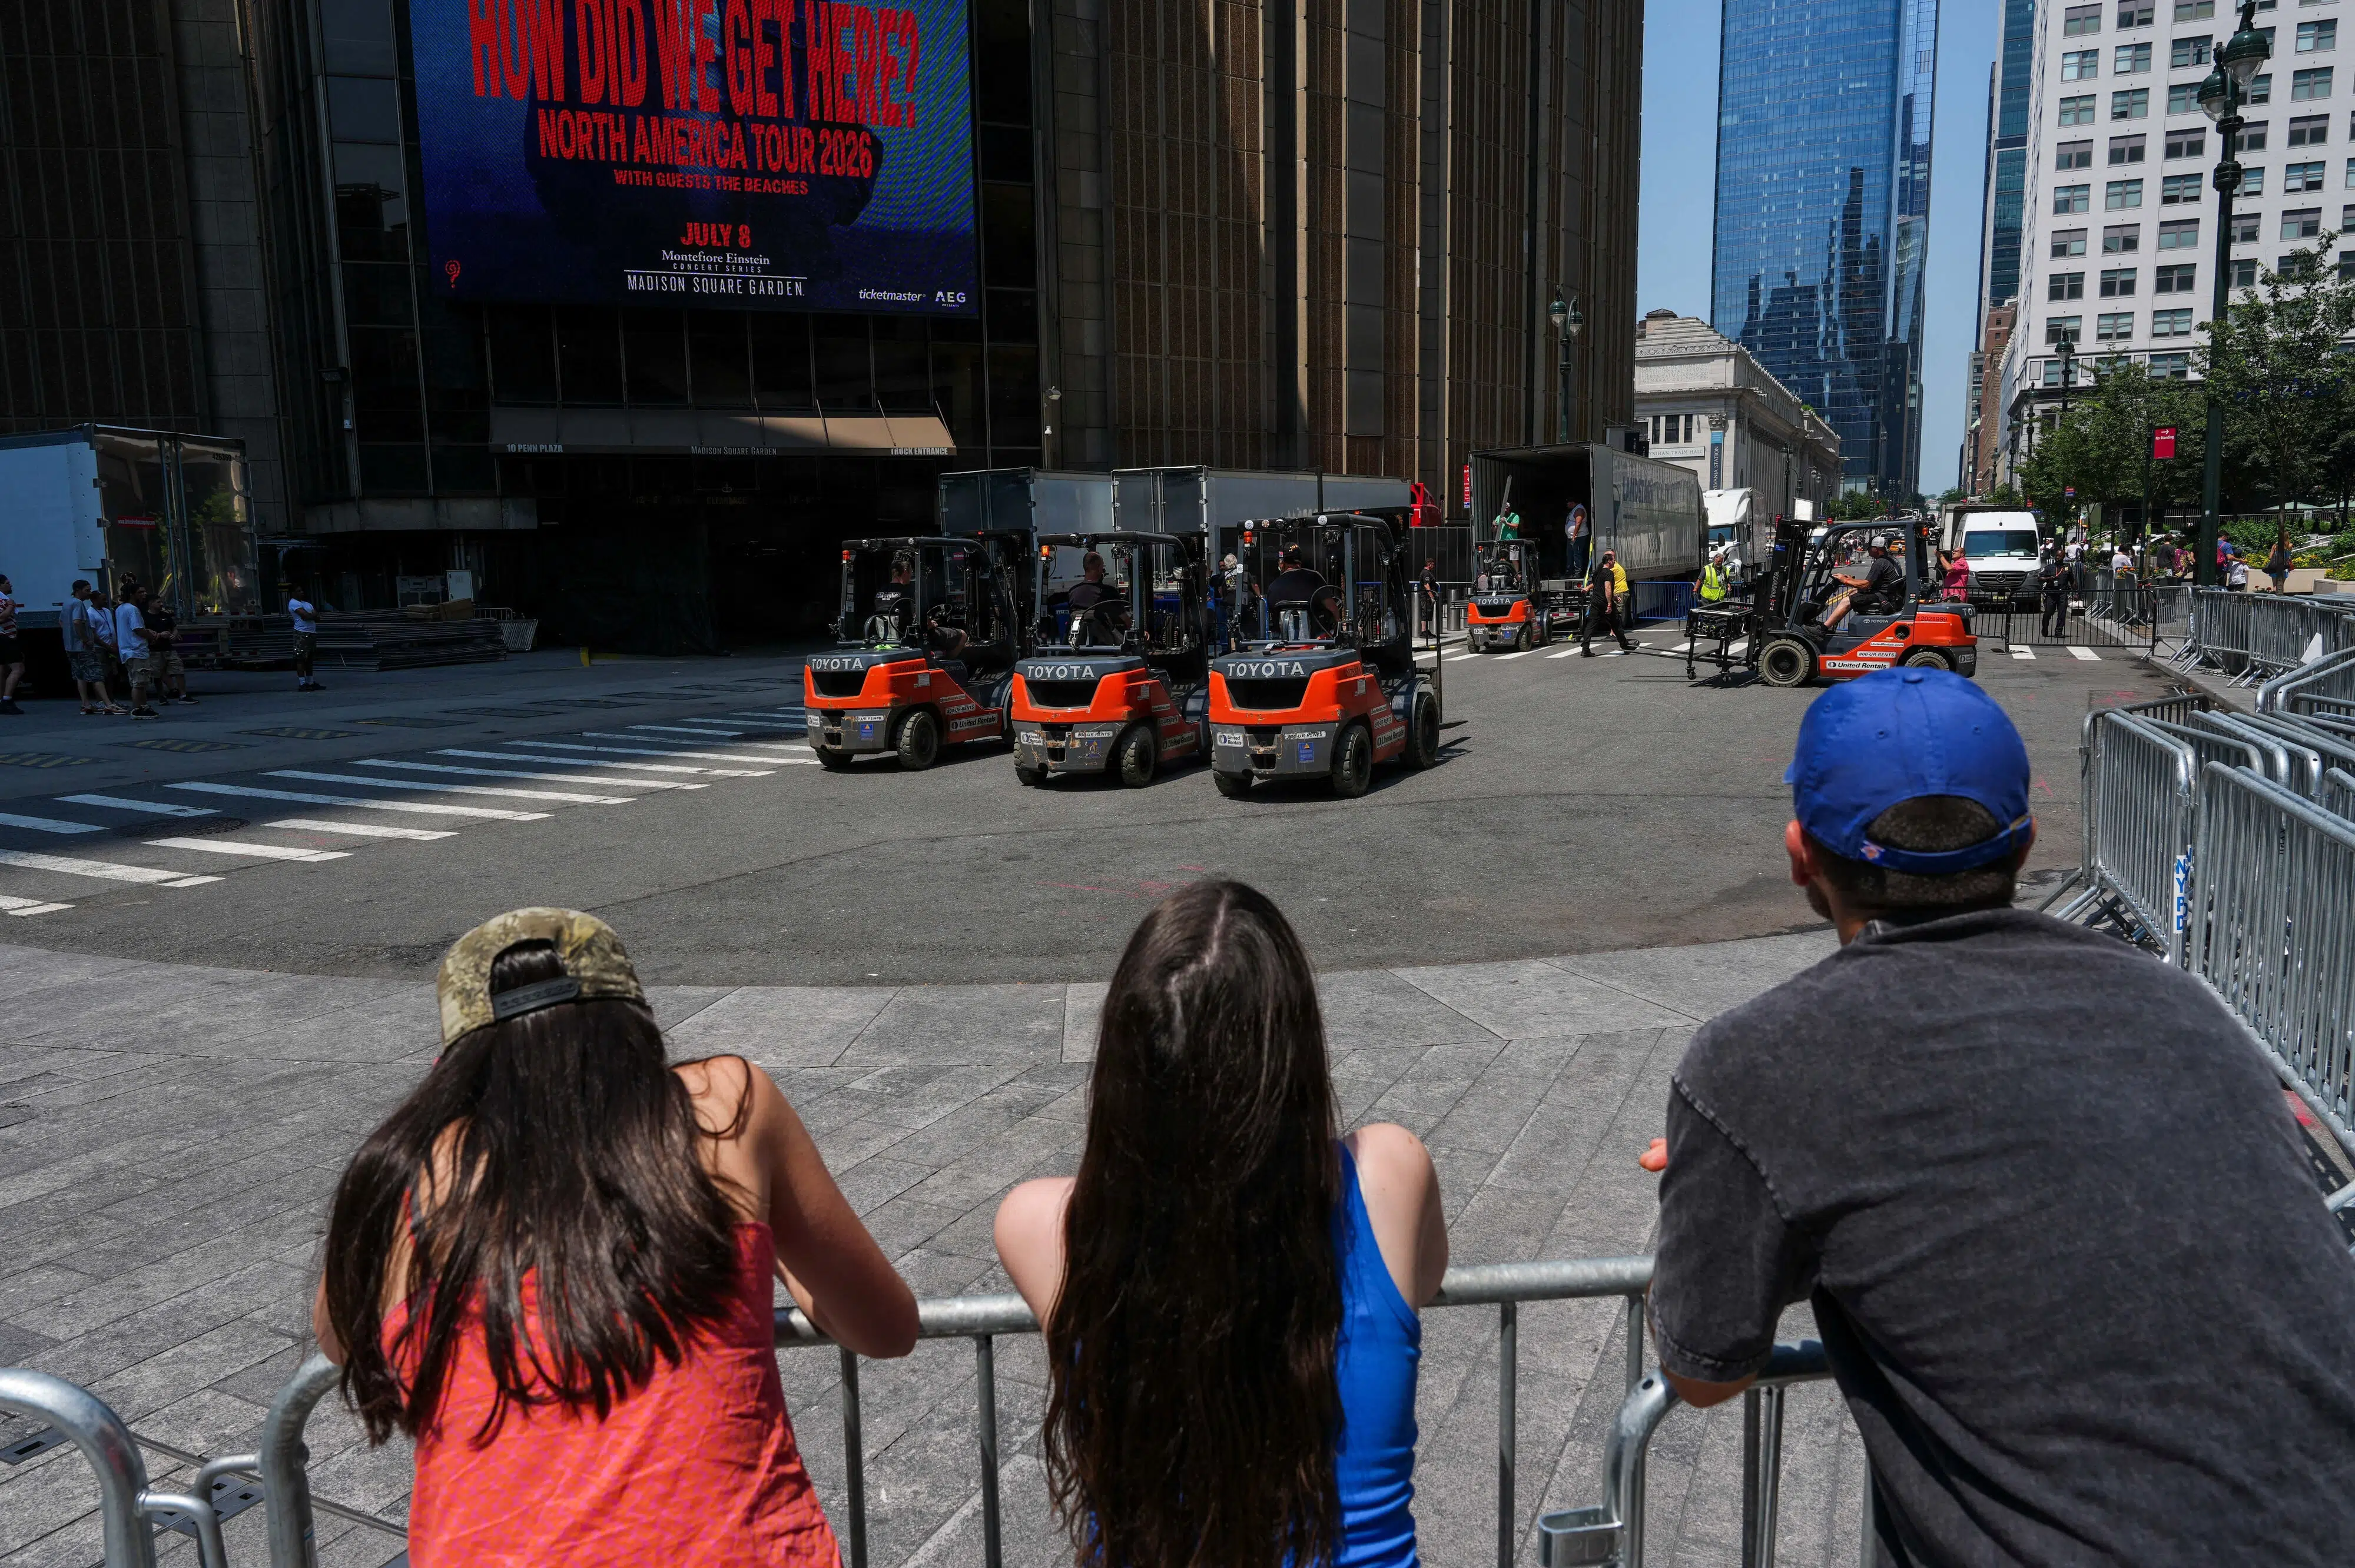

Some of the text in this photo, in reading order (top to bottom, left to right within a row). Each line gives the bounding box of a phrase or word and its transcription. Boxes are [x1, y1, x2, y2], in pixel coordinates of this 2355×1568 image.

[469, 0, 920, 128] HOW DID WE GET HERE?
[538, 108, 873, 178] NORTH AMERICA TOUR 2026
[613, 170, 808, 195] WITH GUESTS THE BEACHES
[681, 222, 751, 248] JULY 8
[662, 250, 771, 265] Montefiore Einstein
[673, 263, 762, 273] CONCERT SERIES
[627, 275, 685, 292] MADISON
[693, 277, 743, 294] SQUARE
[935, 291, 966, 303] AEG
[506, 444, 563, 453] 10 PENN PLAZA
[691, 446, 777, 456] MADISON SQUARE GARDEN
[891, 447, 948, 456] TRUCK ENTRANCE
[1770, 571, 1780, 599] TOYOTA
[812, 657, 864, 670] TOYOTA
[1226, 662, 1305, 677] TOYOTA
[1027, 665, 1095, 679] TOYOTA
[959, 715, 996, 728] United Rentals
[1382, 729, 1404, 745] United Rentals
[2175, 858, 2186, 931] NYPD
